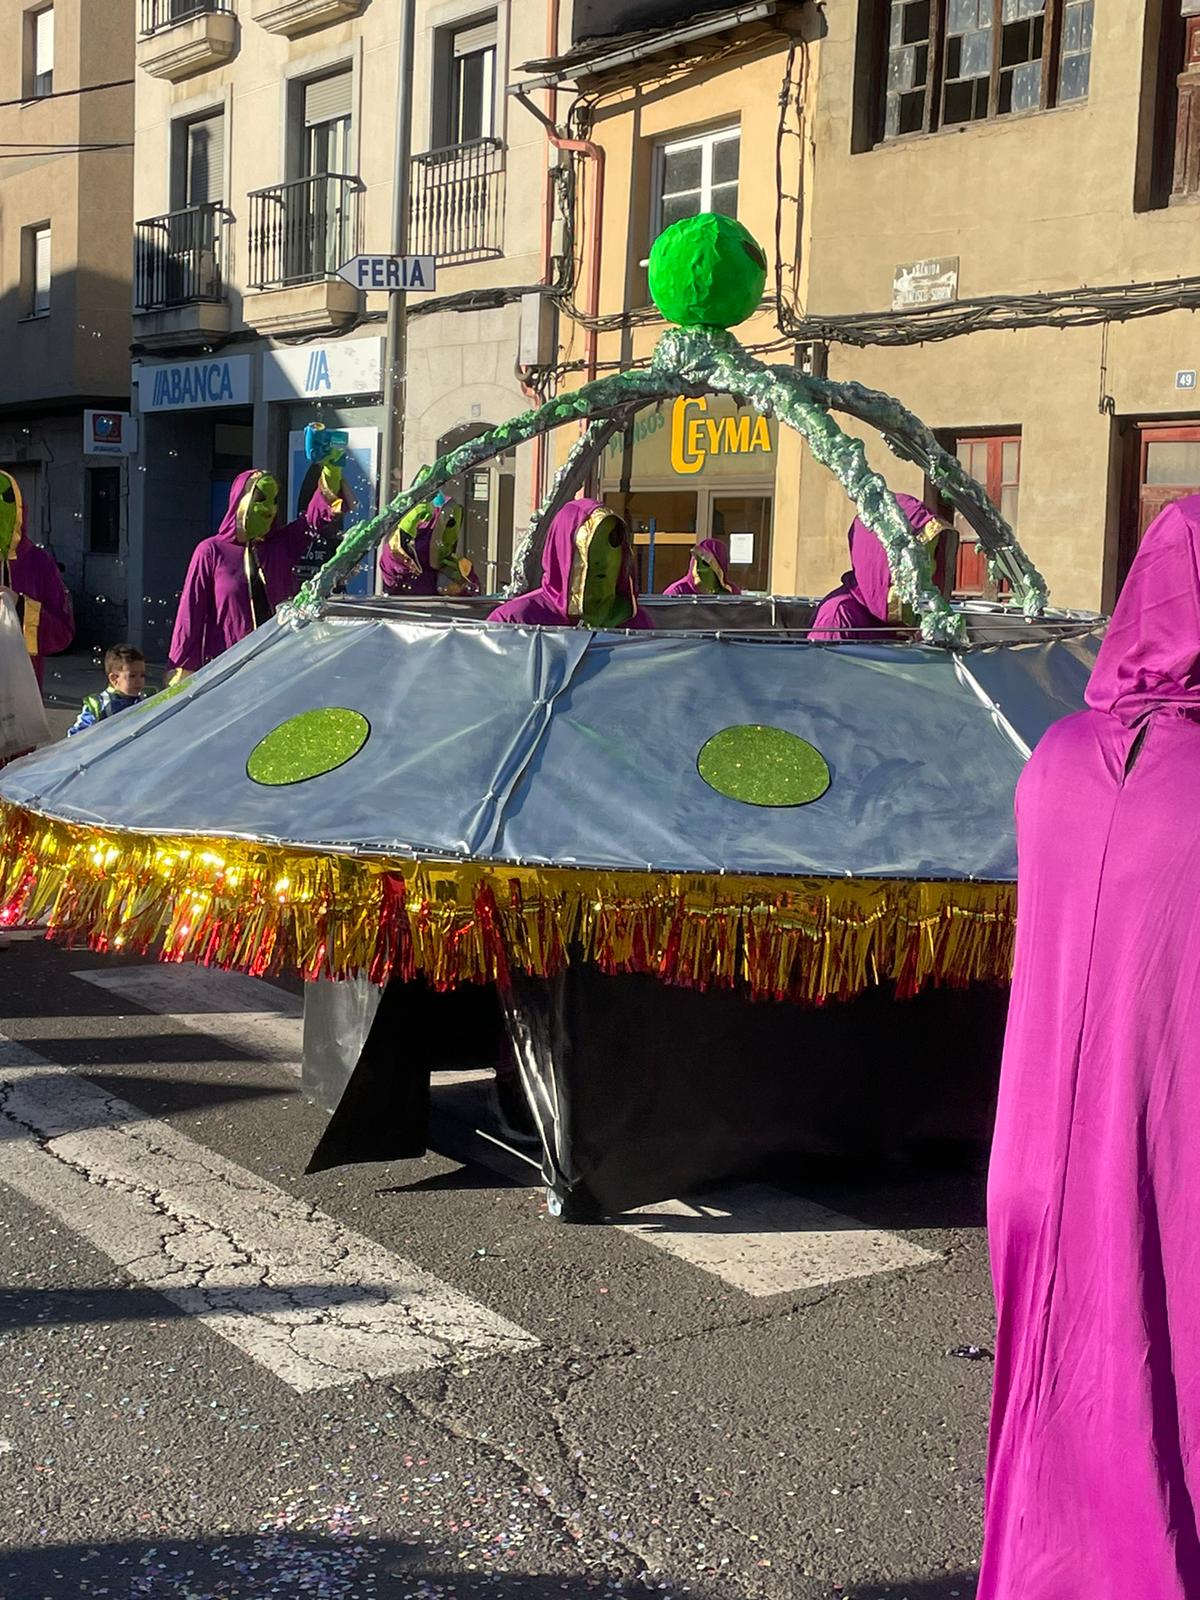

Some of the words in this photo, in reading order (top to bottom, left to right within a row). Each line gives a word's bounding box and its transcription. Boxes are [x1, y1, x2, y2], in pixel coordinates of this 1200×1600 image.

[357, 258, 425, 287] FERIA
[1179, 374, 1193, 386] 49
[671, 395, 771, 474] CEYMA
